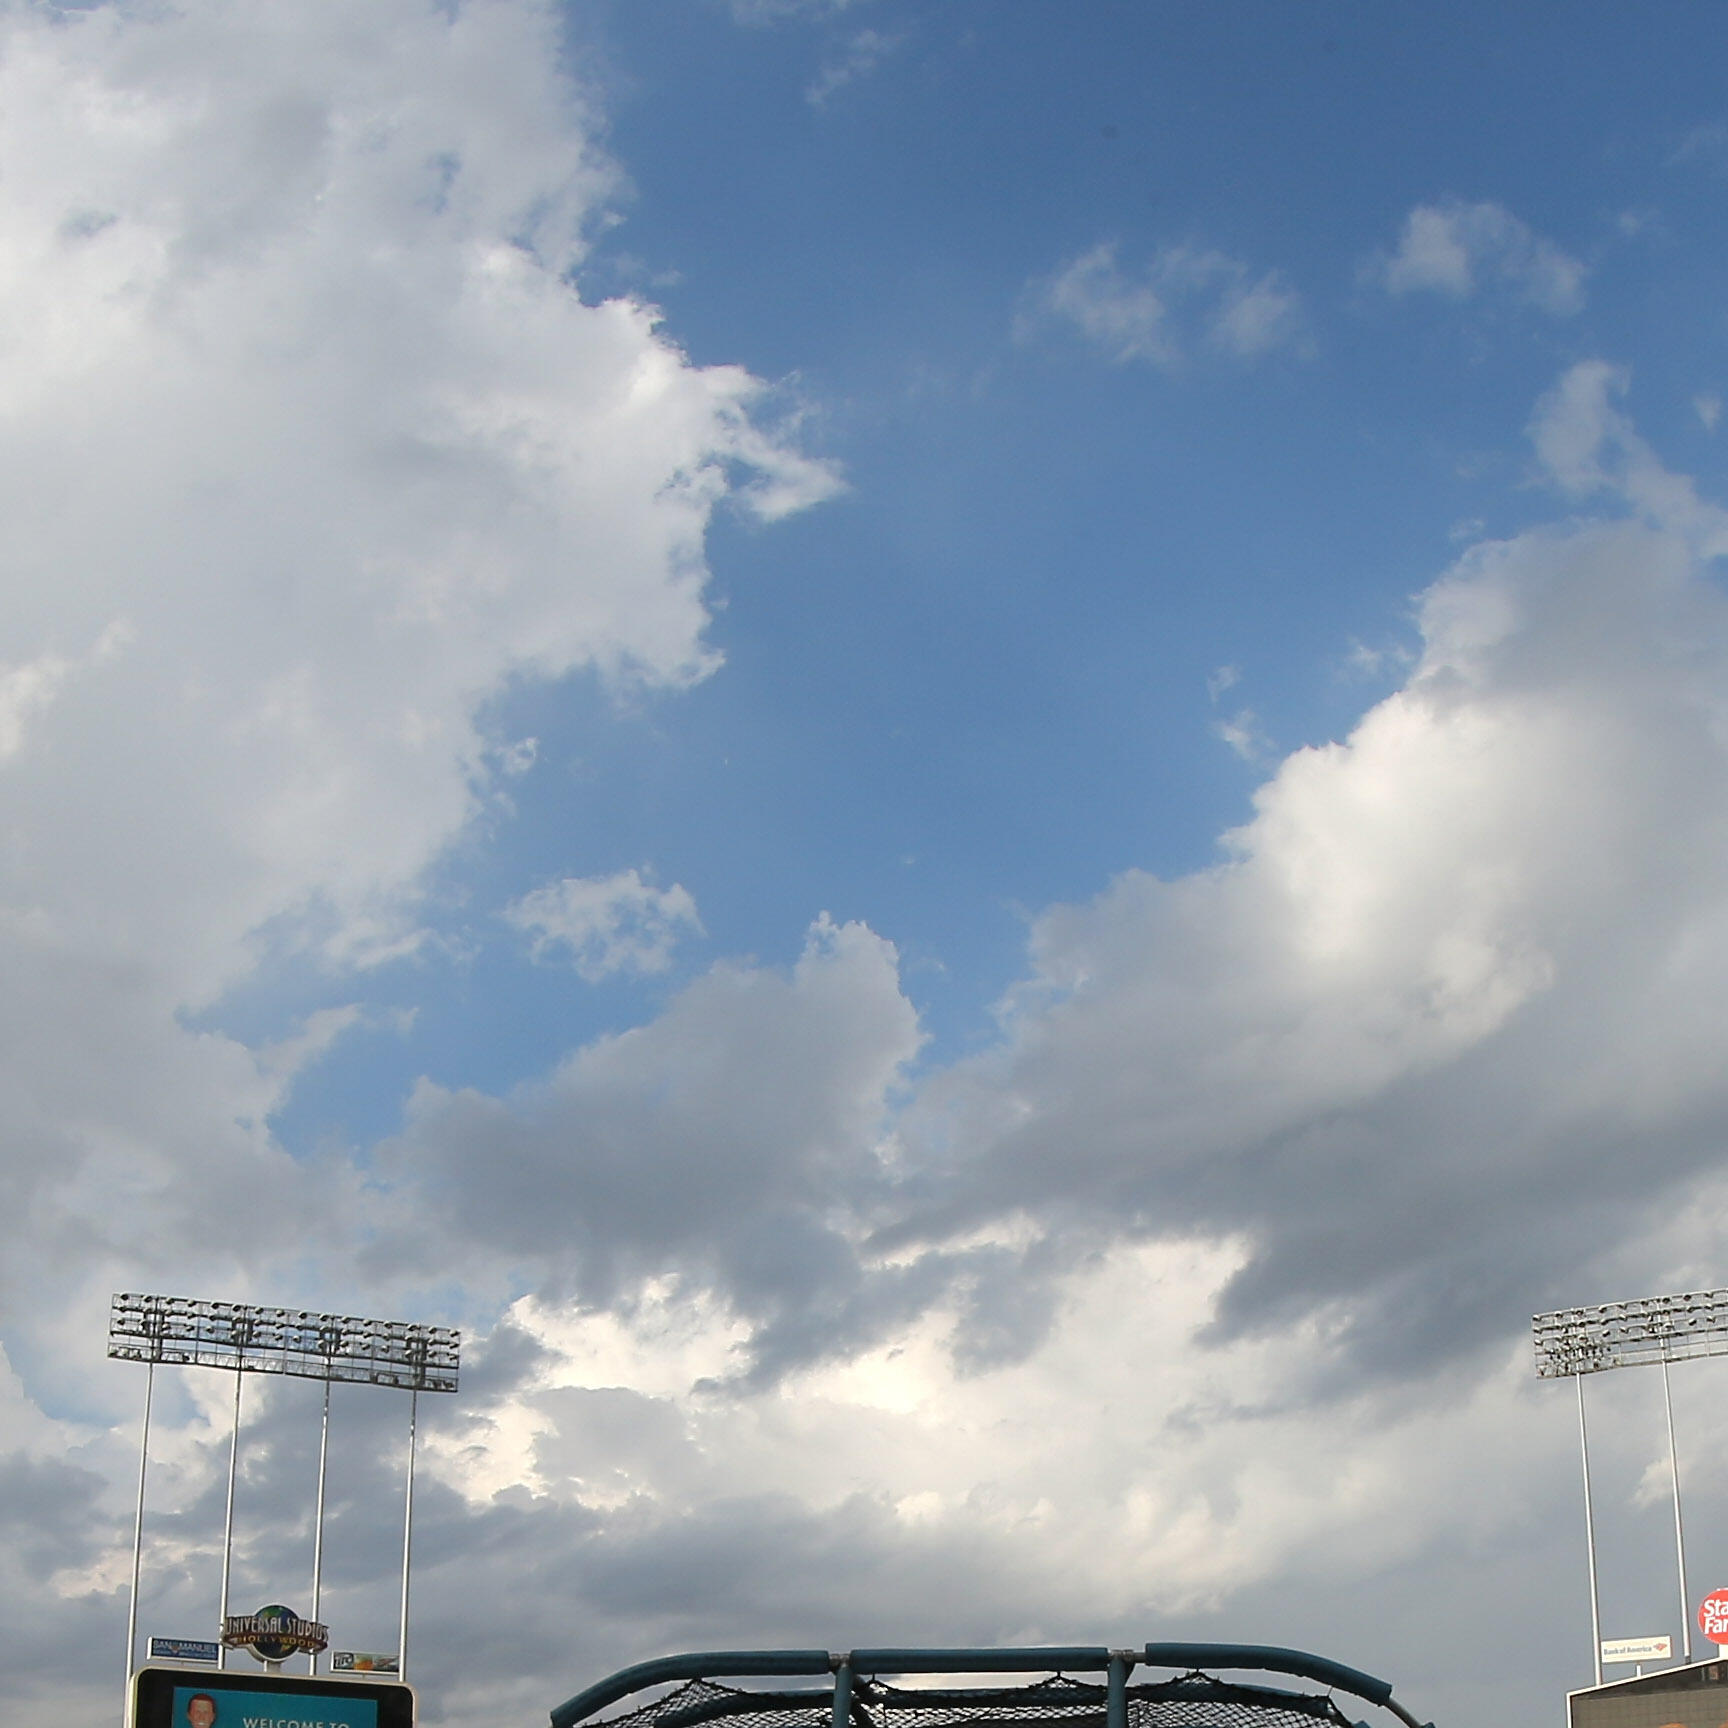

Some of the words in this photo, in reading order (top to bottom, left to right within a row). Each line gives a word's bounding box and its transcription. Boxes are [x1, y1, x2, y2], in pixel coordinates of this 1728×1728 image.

[226, 1616, 283, 1635] UNIVERSAL
[286, 1617, 329, 1642] STUDIOS
[238, 1634, 315, 1648] HOLLYWOOD
[1603, 1648, 1619, 1656] Bank
[1626, 1645, 1653, 1653] America
